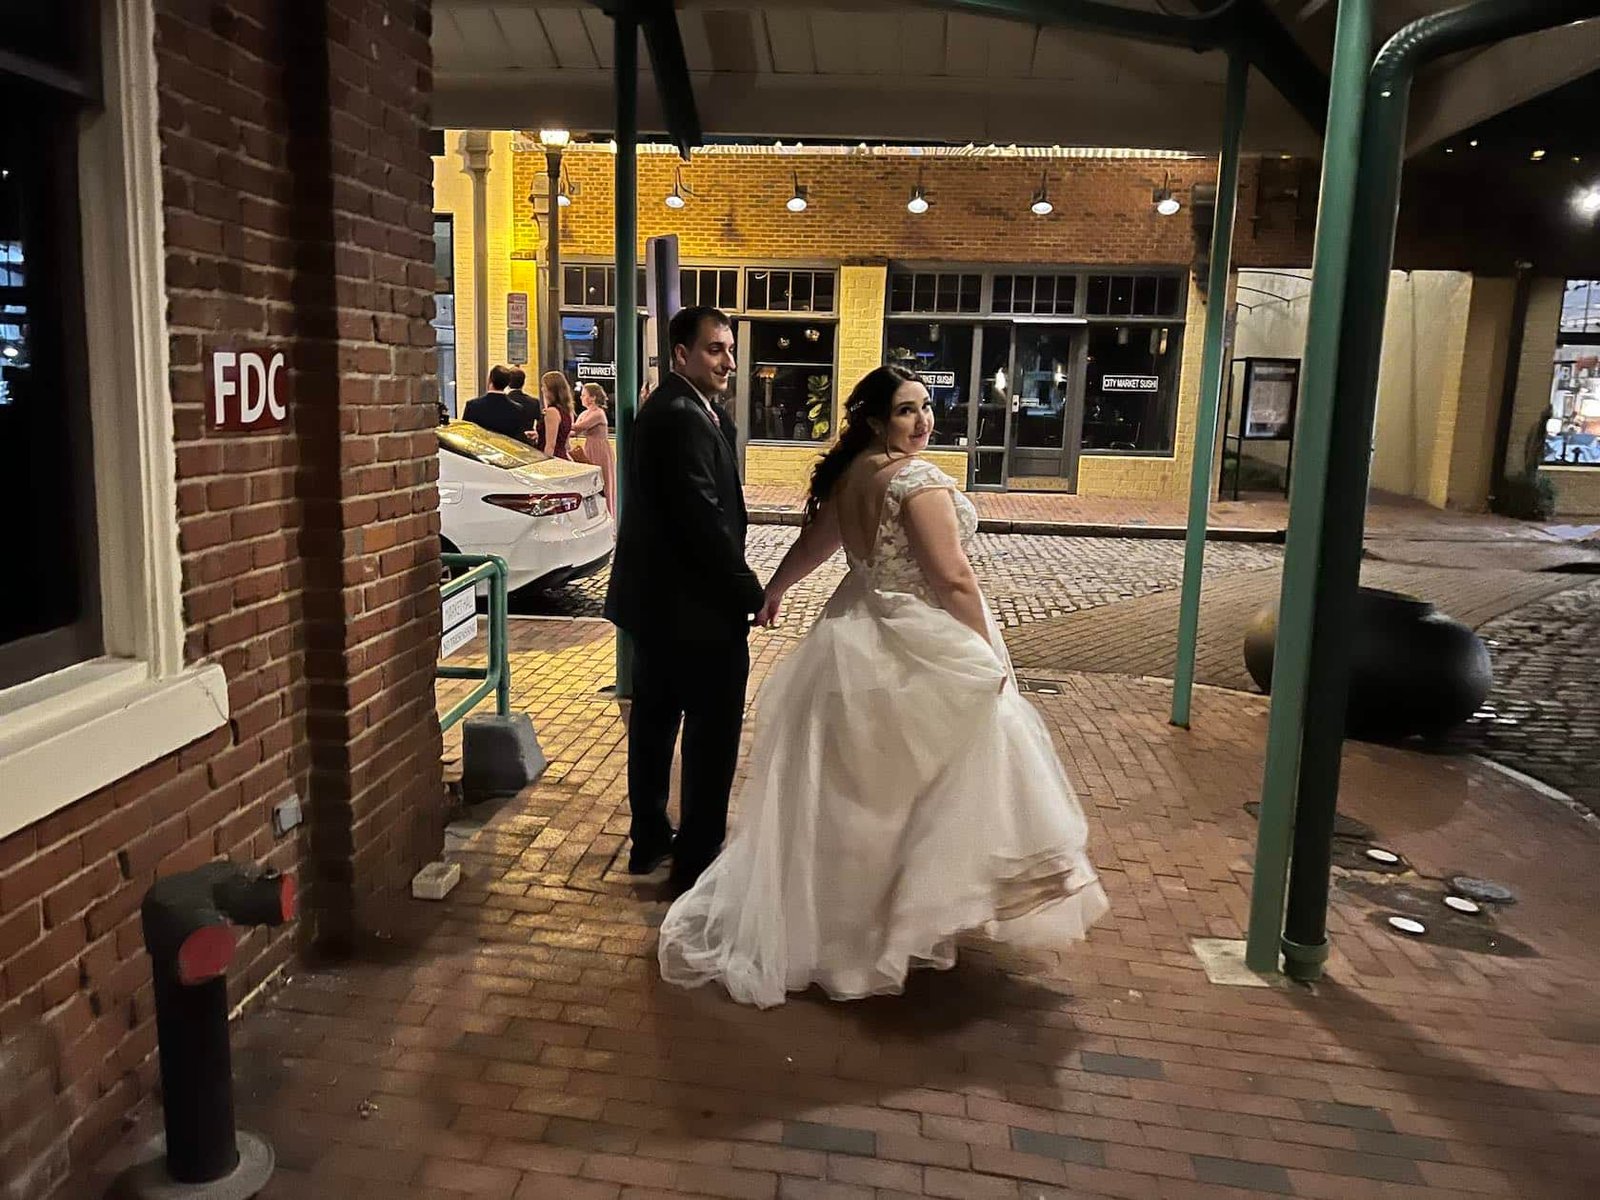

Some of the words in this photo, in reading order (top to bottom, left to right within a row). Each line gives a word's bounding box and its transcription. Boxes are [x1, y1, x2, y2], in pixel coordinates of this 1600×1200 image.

[579, 366, 591, 375] CITY
[590, 366, 611, 376] MARKET
[920, 374, 936, 384] RKET
[1104, 378, 1117, 388] CITY
[1116, 378, 1140, 388] MARKET
[1139, 379, 1157, 389] SUSHI
[213, 352, 286, 424] FDC
